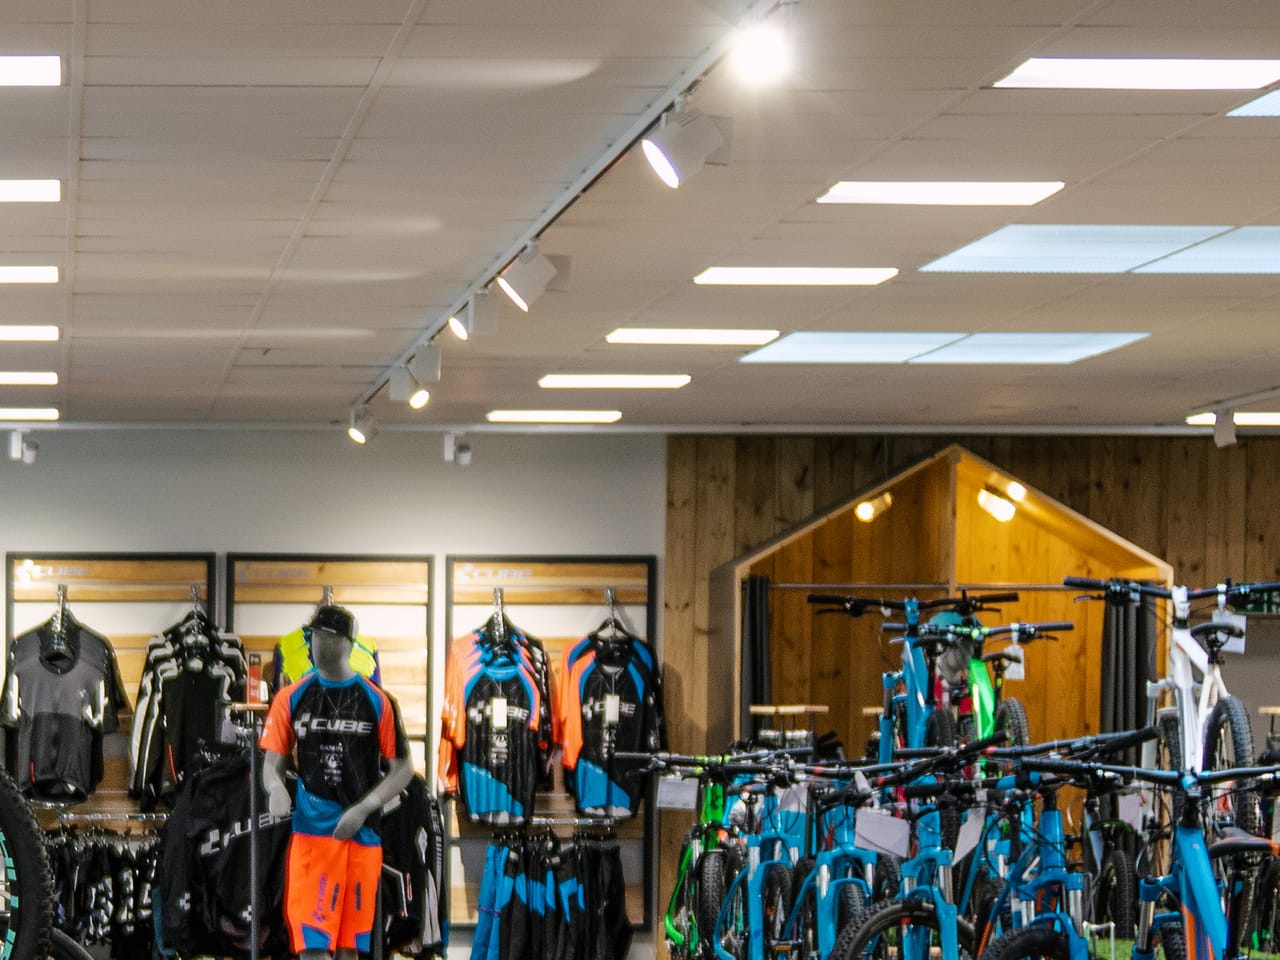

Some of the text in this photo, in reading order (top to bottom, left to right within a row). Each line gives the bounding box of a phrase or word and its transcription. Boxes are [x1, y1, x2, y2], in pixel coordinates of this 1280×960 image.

[485, 704, 530, 721] CBE
[594, 701, 637, 715] CBE
[310, 718, 373, 734] CUBE
